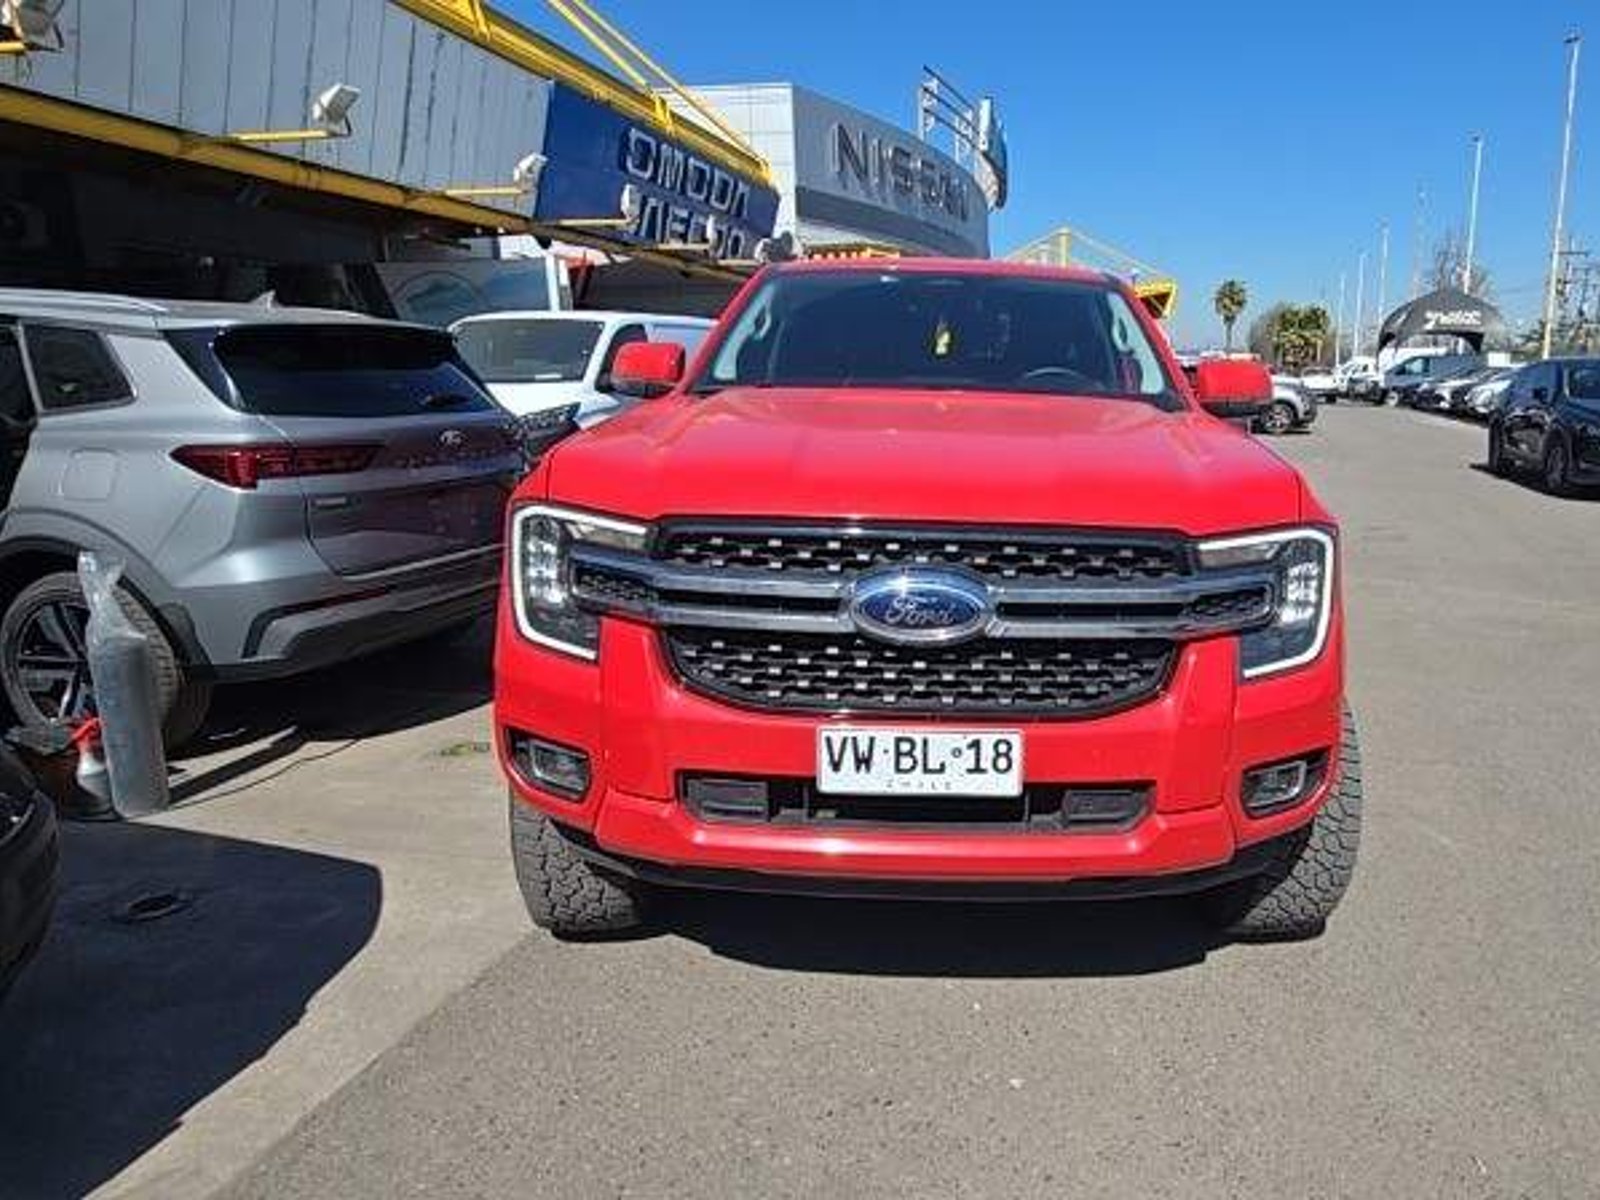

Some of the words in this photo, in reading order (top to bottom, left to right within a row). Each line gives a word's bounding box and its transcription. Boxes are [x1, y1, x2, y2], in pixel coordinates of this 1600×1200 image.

[832, 122, 968, 222] NISSAN
[623, 196, 746, 259] AECO
[884, 595, 954, 624] Ford
